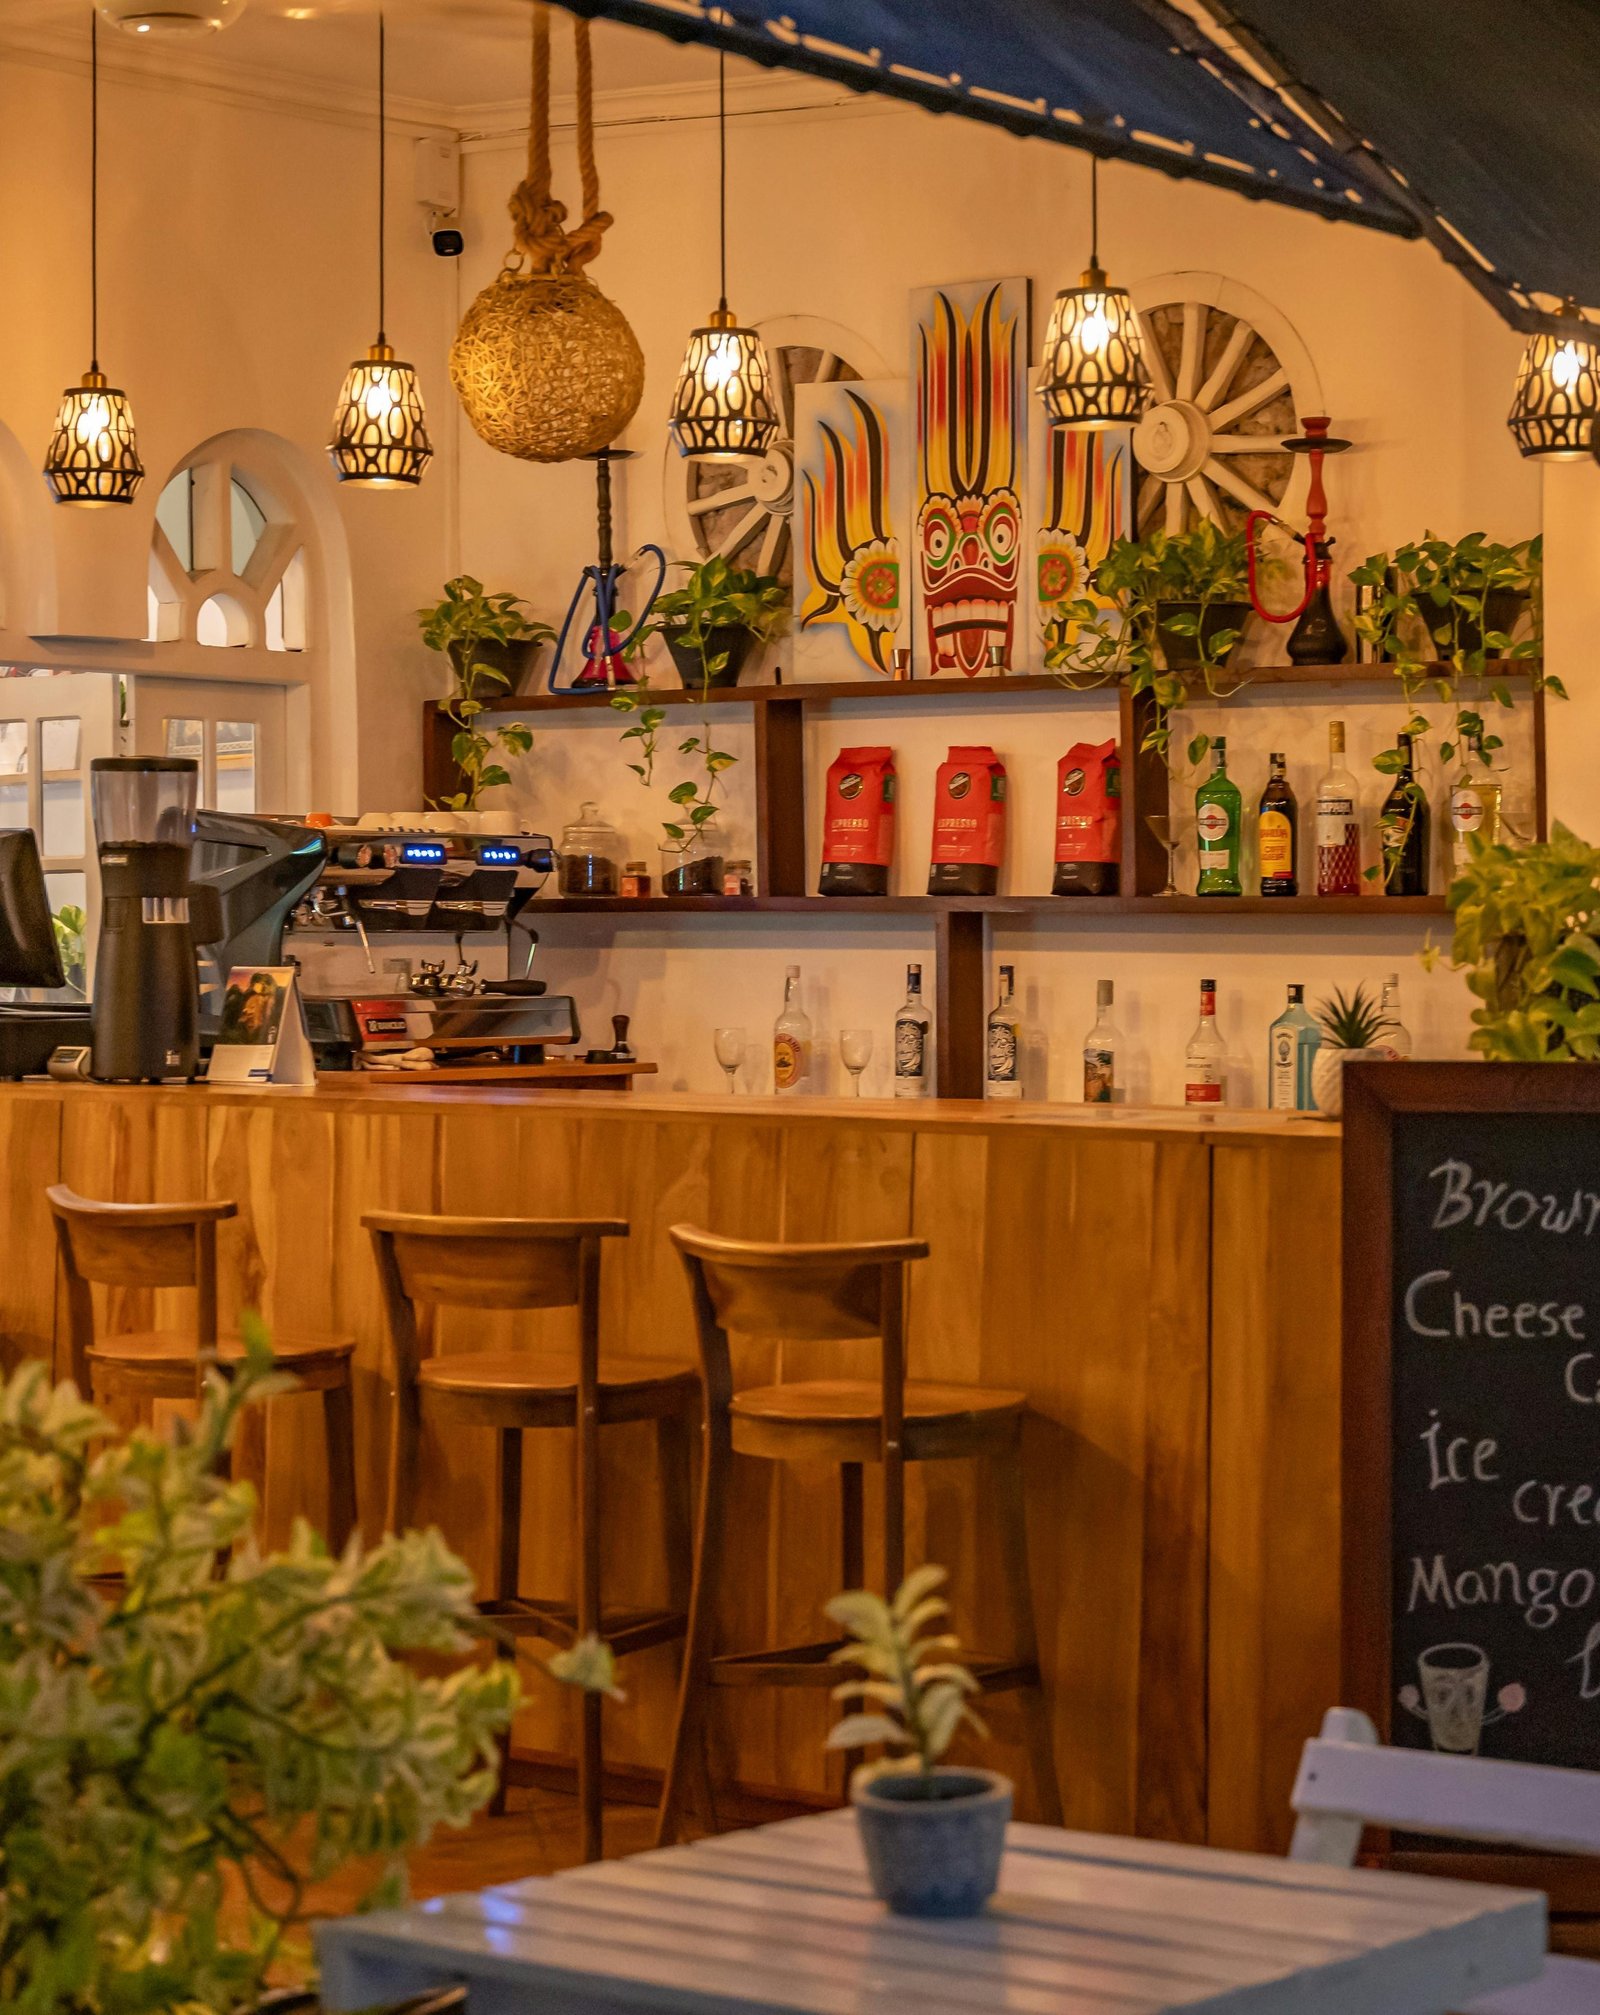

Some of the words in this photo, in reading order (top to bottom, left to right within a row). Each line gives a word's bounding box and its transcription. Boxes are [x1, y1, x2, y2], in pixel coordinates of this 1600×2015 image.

[1404, 1269, 1586, 1341] Cheese
[1564, 1352, 1600, 1404] C
[1512, 1479, 1600, 1527] cre
[1408, 1554, 1596, 1629] Mango
